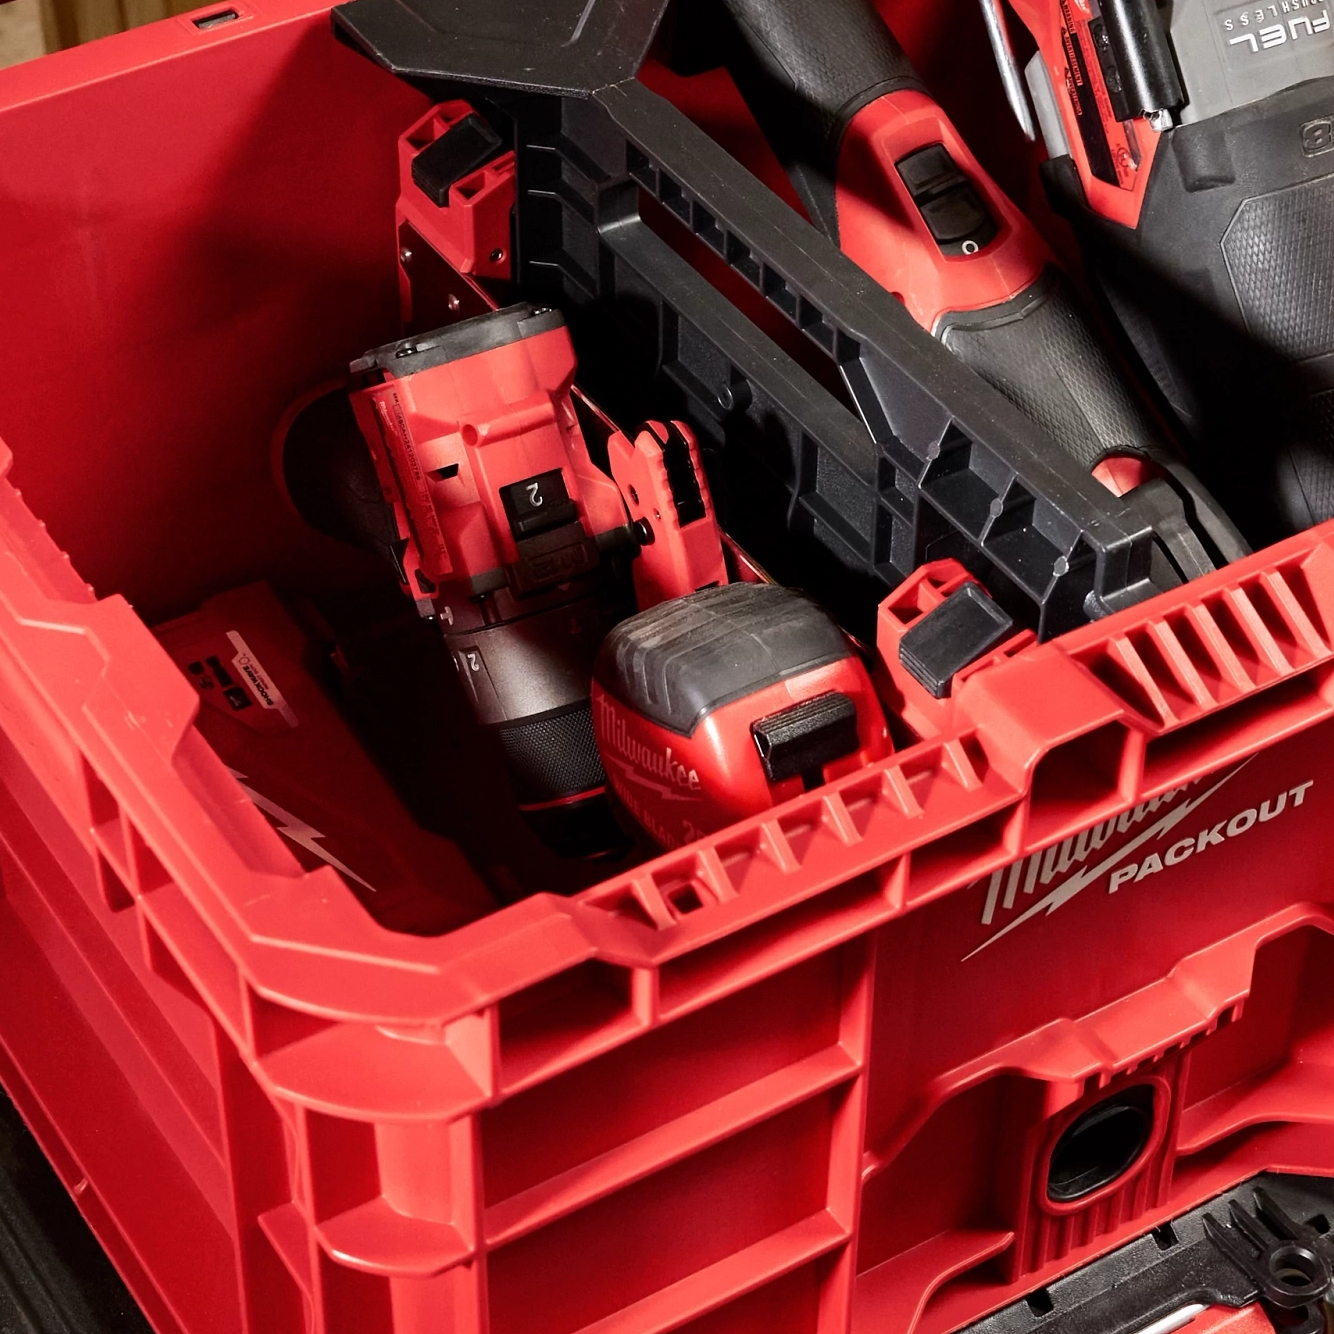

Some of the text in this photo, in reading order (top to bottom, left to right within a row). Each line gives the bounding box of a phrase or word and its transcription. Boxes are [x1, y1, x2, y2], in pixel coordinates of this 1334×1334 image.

[1063, 4, 1076, 34] WARNING
[1229, 9, 1331, 53] FUEL
[525, 482, 543, 507] 2
[466, 653, 480, 672] 2
[596, 693, 702, 791] Milwaukee
[1108, 779, 1314, 895] PACKOUT
